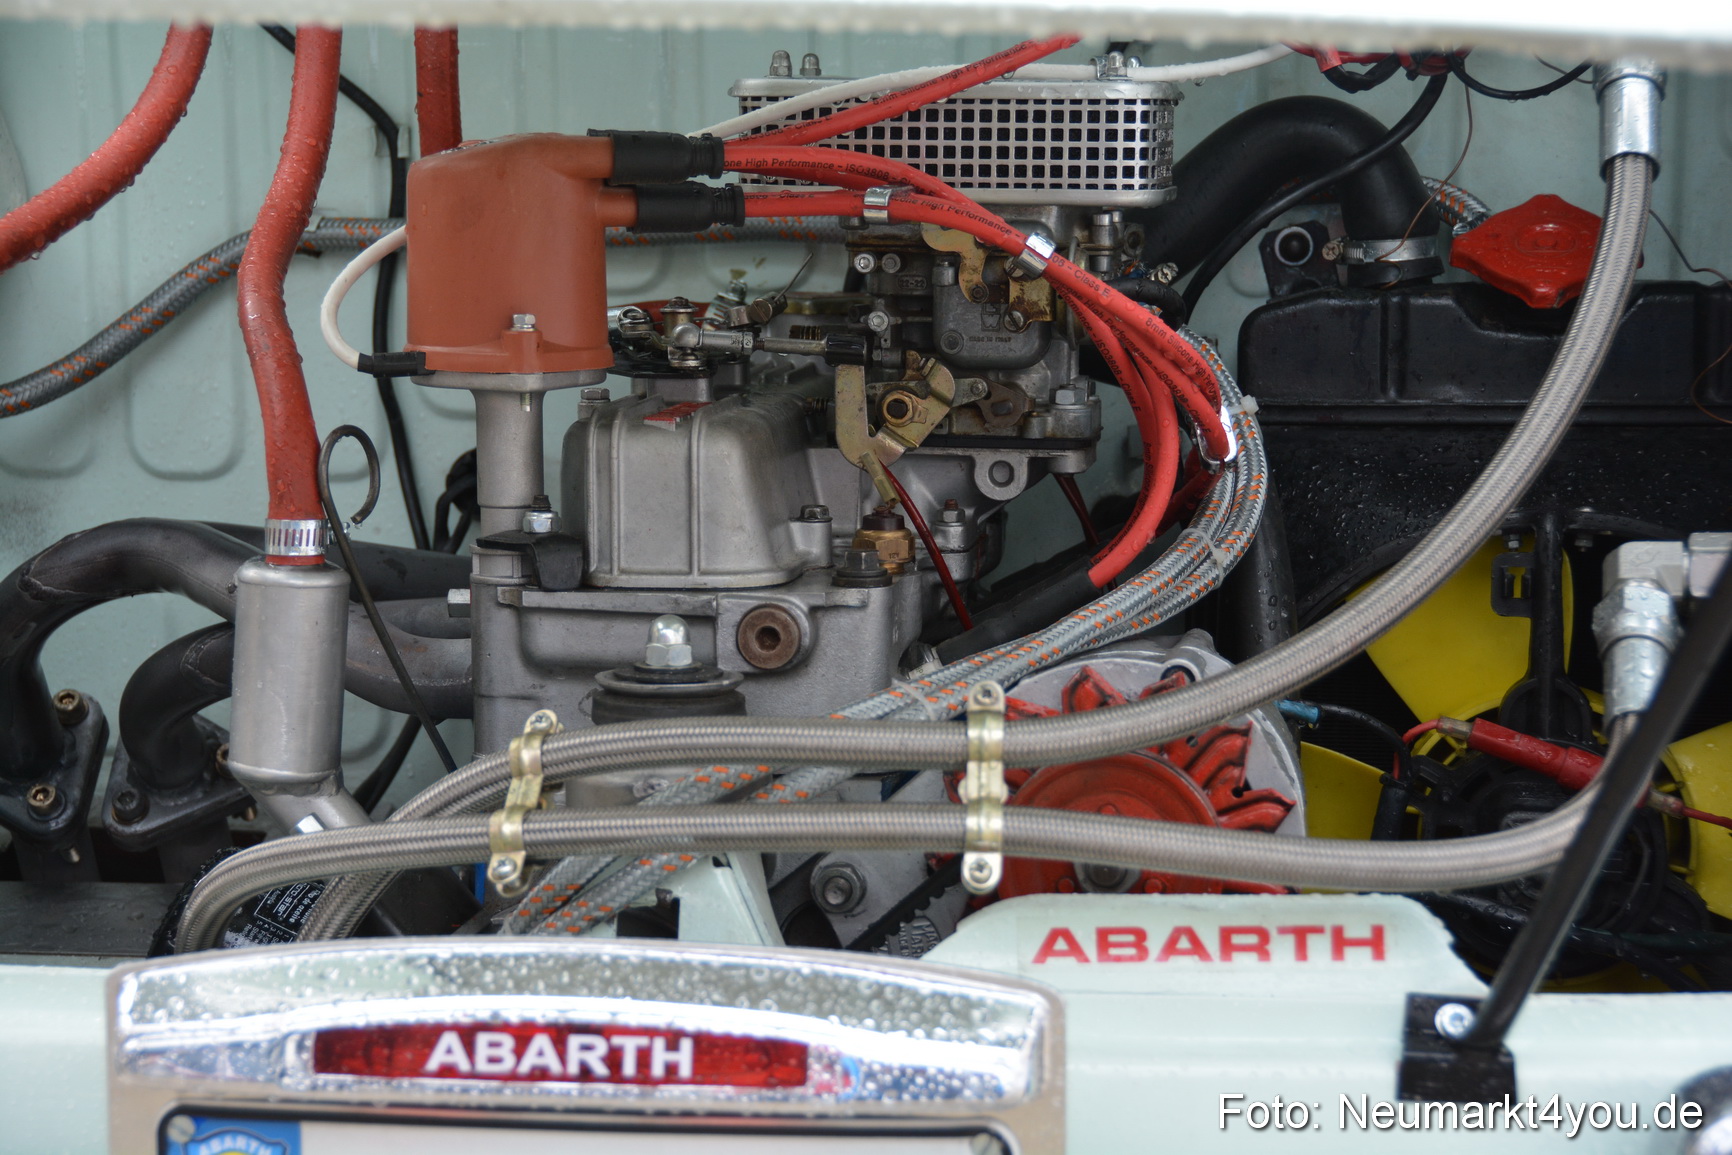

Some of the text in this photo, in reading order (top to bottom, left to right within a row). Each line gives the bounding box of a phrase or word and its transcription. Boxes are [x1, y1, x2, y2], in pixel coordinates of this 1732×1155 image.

[745, 158, 769, 169] High
[771, 158, 835, 171] Performance
[845, 163, 890, 181] ISO3808
[920, 200, 945, 211] High
[947, 205, 1013, 237] Performance
[1074, 269, 1101, 292] Class
[1101, 286, 1111, 298] E
[1145, 317, 1167, 339] 8mm
[1167, 335, 1194, 365] Silicone
[1083, 297, 1105, 319] High
[1104, 317, 1153, 367] Performance
[1096, 338, 1123, 378] ISO3808
[1121, 382, 1137, 406] Class
[1032, 925, 1387, 966] ABARTH
[424, 1030, 694, 1080] ABARTH
